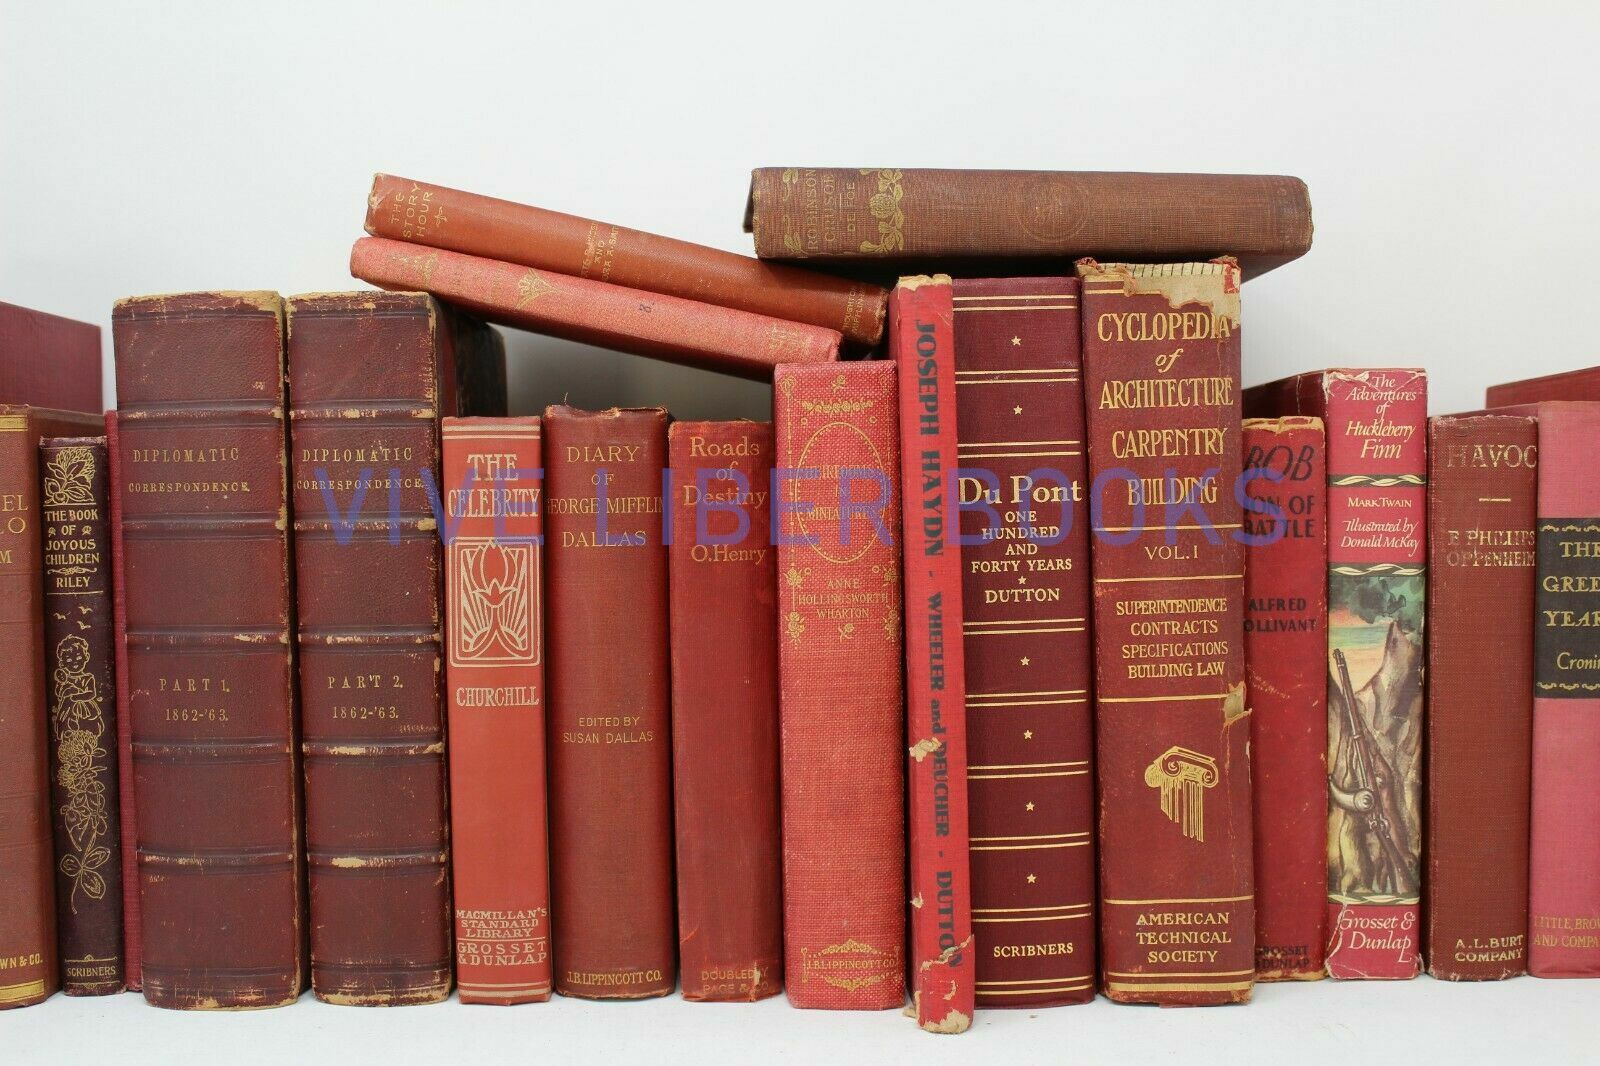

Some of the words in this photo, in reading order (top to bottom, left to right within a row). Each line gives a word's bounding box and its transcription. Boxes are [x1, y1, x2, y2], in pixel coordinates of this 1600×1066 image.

[390, 191, 405, 225] THE
[402, 183, 423, 238] STORY
[416, 191, 434, 238] HOUR
[1098, 312, 1231, 342] CYCLOPEDIA
[1155, 348, 1184, 373] of
[915, 319, 940, 436] JOSEPH
[1372, 373, 1396, 389] The
[1099, 377, 1234, 409] ARCHITECTURE
[1345, 386, 1417, 402] Adventures
[1376, 400, 1392, 422] of
[1345, 418, 1416, 443] Huckleberry
[689, 435, 761, 458] Roads
[1112, 427, 1228, 459] CARPENTRY
[1360, 438, 1402, 460] Finn
[132, 448, 240, 463] DIPLOMATIC
[302, 447, 413, 462] DIPLOMATIC
[566, 445, 642, 464] DIARY
[1447, 444, 1538, 468] HAVOC
[467, 453, 520, 482] THE
[716, 460, 738, 482] of
[591, 473, 615, 486] OF
[683, 484, 767, 508] Destiny
[958, 477, 1002, 505] Du
[1010, 475, 1082, 503] Pont
[1127, 476, 1217, 506] BUILDING
[448, 487, 541, 519] CELEBRITY
[921, 450, 944, 557] HAYDN
[1289, 495, 1315, 515] OF
[46, 510, 68, 522] THE
[69, 508, 99, 521] BOOK
[1005, 510, 1037, 523] ONE
[61, 525, 77, 536] OF
[982, 526, 1060, 541] HUNDRED
[1342, 519, 1401, 534] Illustrated
[1402, 519, 1419, 539] by
[46, 538, 97, 552] JOYOUS
[562, 530, 647, 549] DALLAS
[1341, 534, 1382, 548] Donald
[1383, 534, 1420, 557] McKay
[1005, 543, 1037, 556] AND
[1144, 545, 1190, 560] VOL.
[45, 553, 100, 566] CHILDREN
[971, 561, 1019, 574] FORTY
[1027, 559, 1072, 572] YEARS
[1446, 550, 1536, 568] OPPENHEIM
[56, 576, 91, 588] RILEY
[827, 578, 860, 590] ANNE
[985, 588, 1060, 604] DUTTON
[1116, 598, 1228, 616] SUPERINTENDENCE
[1248, 597, 1307, 612] ALFRED
[815, 607, 870, 619] WHARTON
[1131, 619, 1219, 636] CONTRACTS
[1243, 617, 1318, 633] OLLIVANT
[928, 591, 945, 691] WHEELER
[1122, 641, 1229, 659] SPECIFICATIONS
[1556, 651, 1600, 670] Croni
[1128, 663, 1192, 679] BUILDING
[1197, 661, 1226, 676] LAW
[159, 678, 210, 692] PART
[327, 675, 381, 689] PART
[392, 675, 404, 689] 2.
[456, 686, 540, 707] CHURCHILL
[579, 716, 621, 728] EDITED
[623, 716, 641, 727] BY
[931, 698, 946, 734] and
[563, 731, 600, 745] SUSAN
[605, 730, 654, 744] DALLAS
[456, 907, 548, 920] MACMILLAN'S
[1136, 912, 1230, 927] AMERICAN
[1340, 908, 1399, 931] Grosset
[1400, 910, 1415, 930] &
[461, 918, 539, 929] STANDARD
[465, 928, 534, 938] LIBRARY
[1136, 931, 1231, 945] TECHNICAL
[1533, 933, 1558, 947] AND
[457, 941, 547, 955] GROSSET
[993, 942, 1073, 958] SCRIBNERS
[1349, 930, 1412, 964] Dunlap
[19, 955, 28, 967] &
[29, 953, 44, 966] CO.
[470, 953, 547, 966] DUNLAP
[1147, 951, 1218, 964] SOCIETY
[1454, 948, 1523, 963] COMPANY
[66, 965, 117, 978] SCRIBNERS
[645, 970, 662, 982] CO.
[703, 983, 735, 995] PAGE
[739, 982, 750, 994] &
